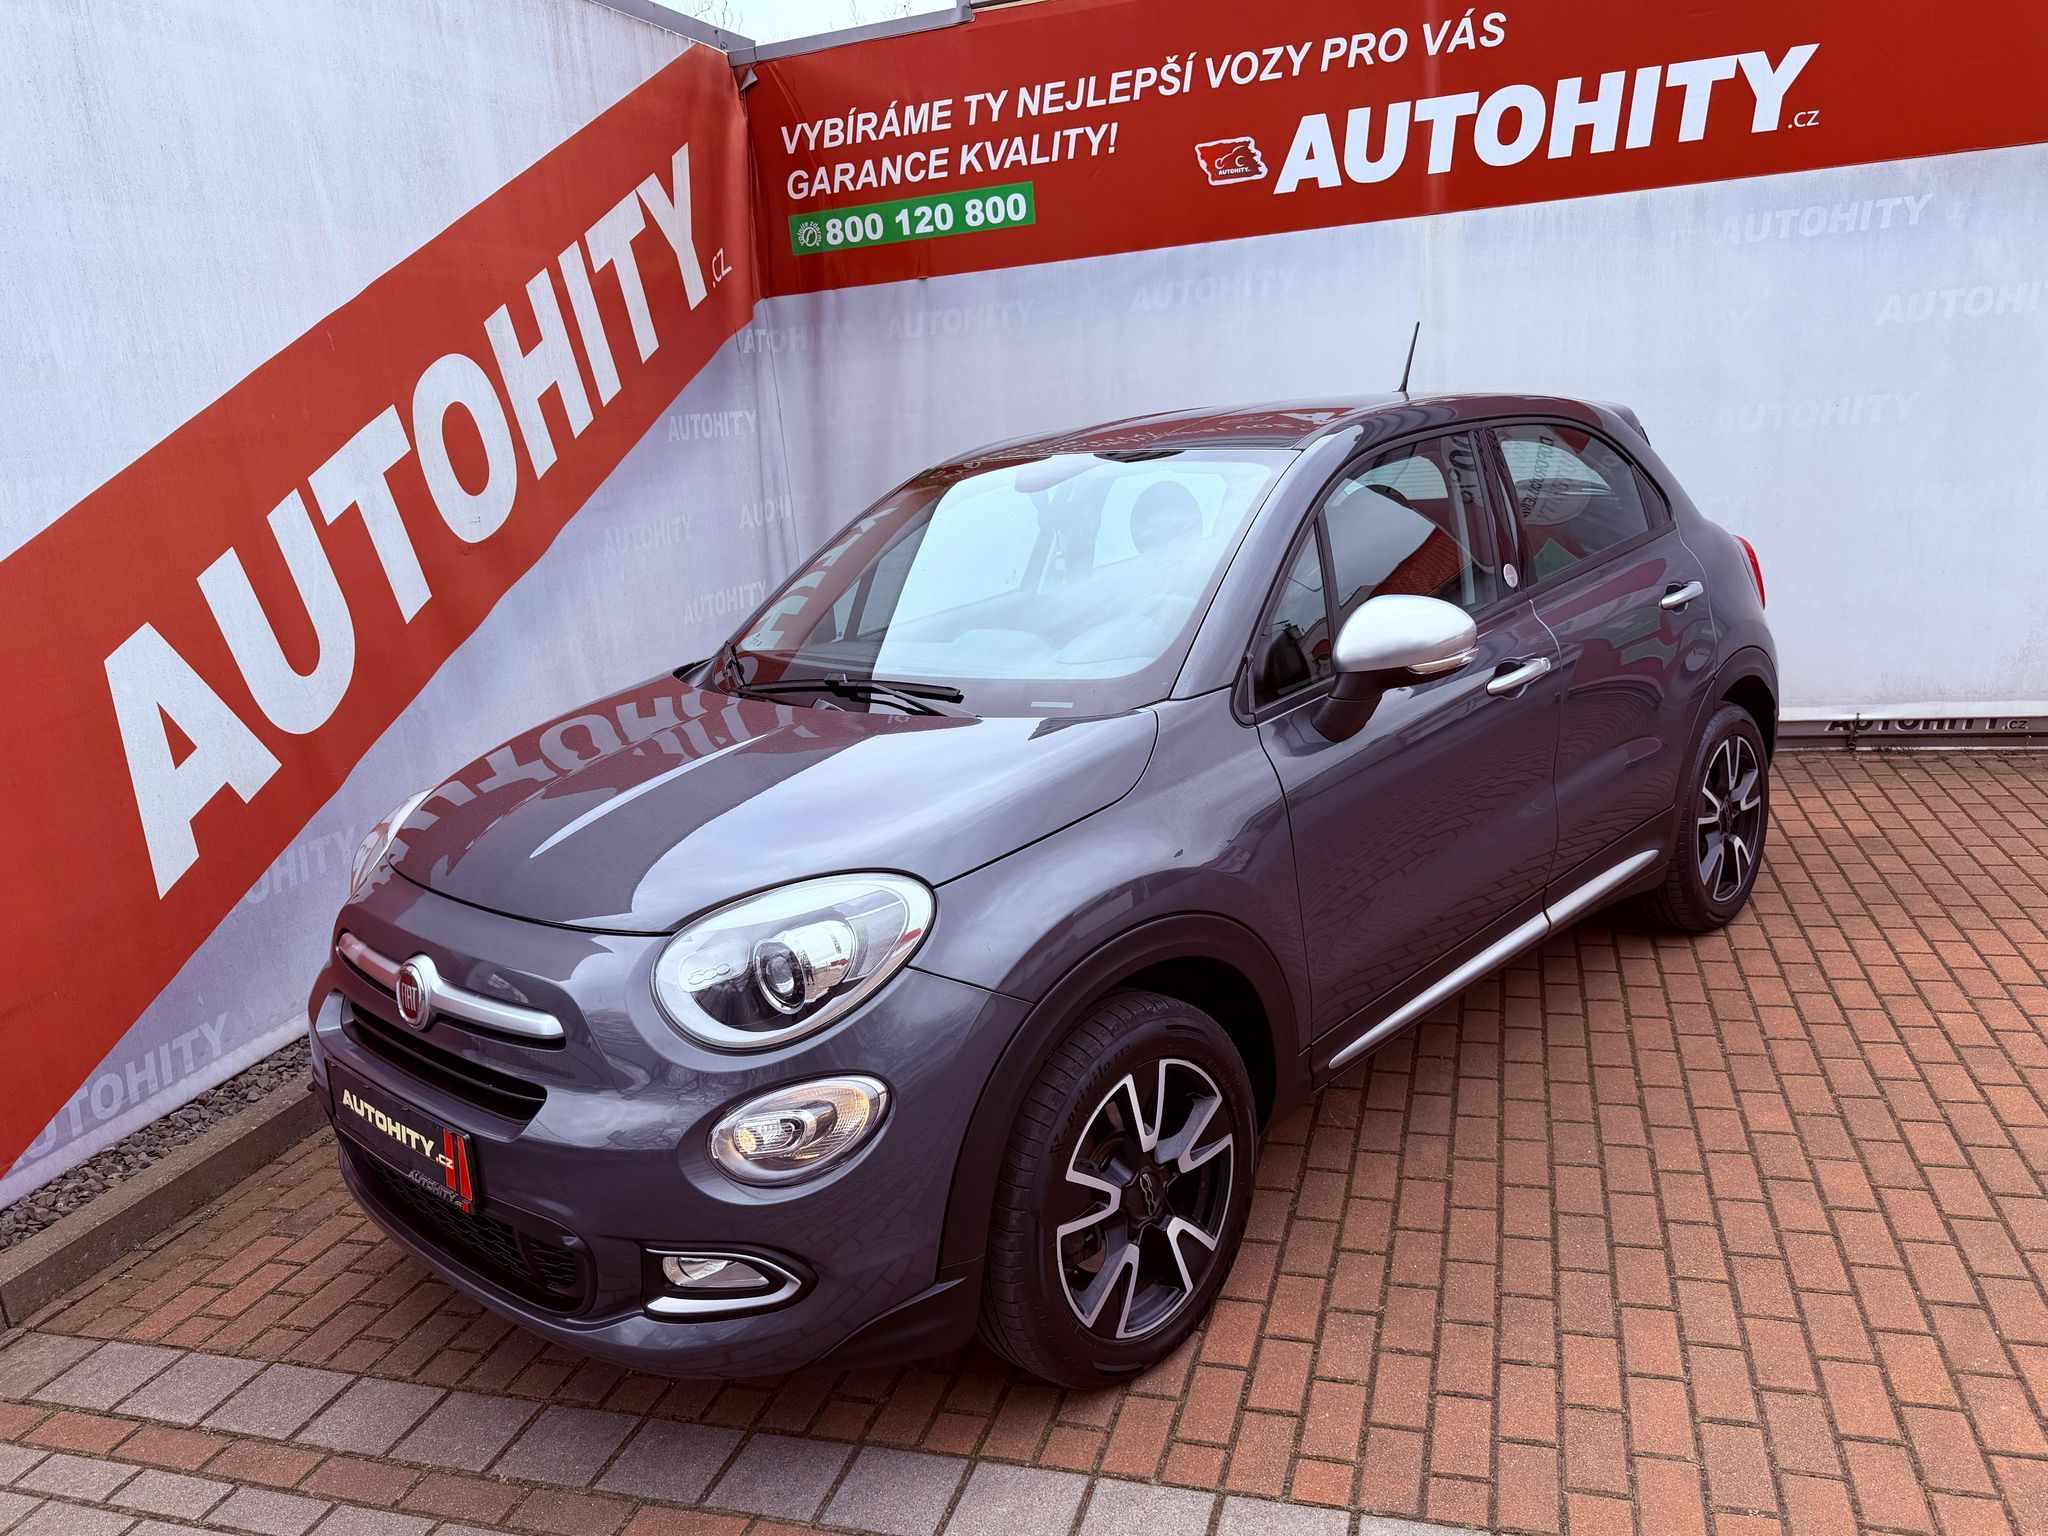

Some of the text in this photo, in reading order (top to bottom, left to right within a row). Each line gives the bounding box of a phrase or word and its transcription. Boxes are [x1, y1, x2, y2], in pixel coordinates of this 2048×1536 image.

[781, 8, 1508, 155] VYBÍRÁME TY NEJLEPŠÍ VOZY PRO VÁS
[787, 122, 1119, 200] GARANCE KVALITY!
[825, 193, 1027, 246] 800 120 800
[1716, 194, 1933, 245] AUTOHITY
[1874, 281, 2048, 327] AUTOHI
[668, 408, 758, 442] AUTOHITY
[683, 578, 767, 627] AUTOHITY
[402, 982, 417, 1011] FIAT
